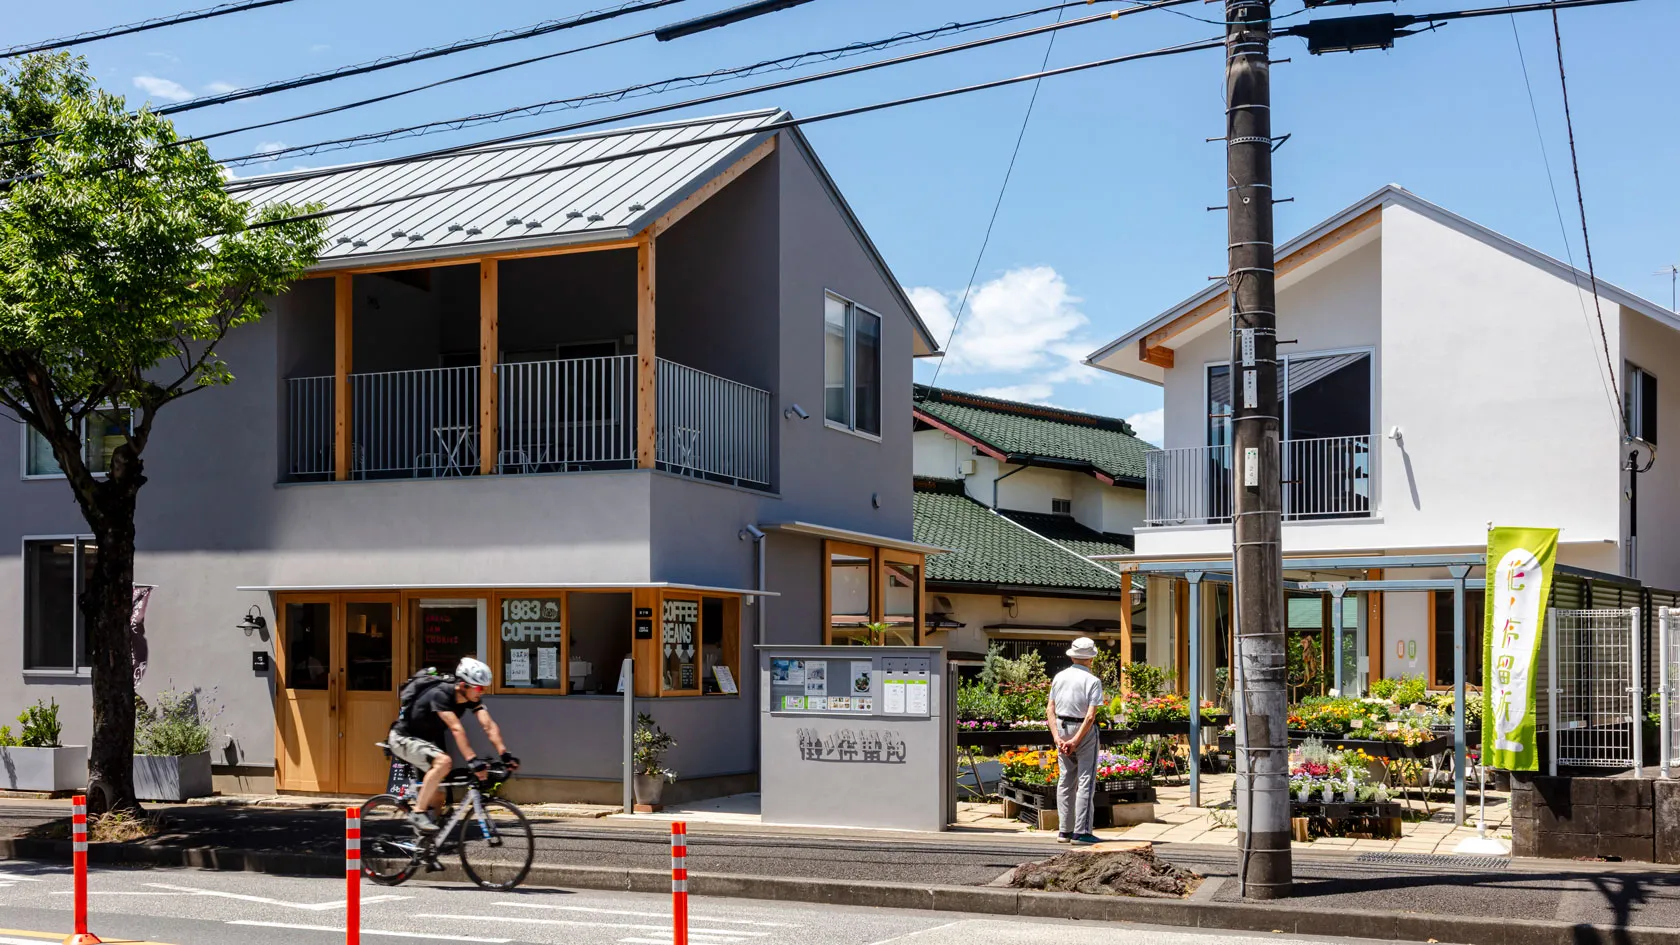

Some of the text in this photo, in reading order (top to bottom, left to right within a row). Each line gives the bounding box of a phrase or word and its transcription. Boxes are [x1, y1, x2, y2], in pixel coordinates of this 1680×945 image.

[501, 600, 541, 620] 1983
[663, 601, 698, 622] COFFEE
[501, 621, 561, 642] COFFEE
[663, 622, 692, 644] BEANS
